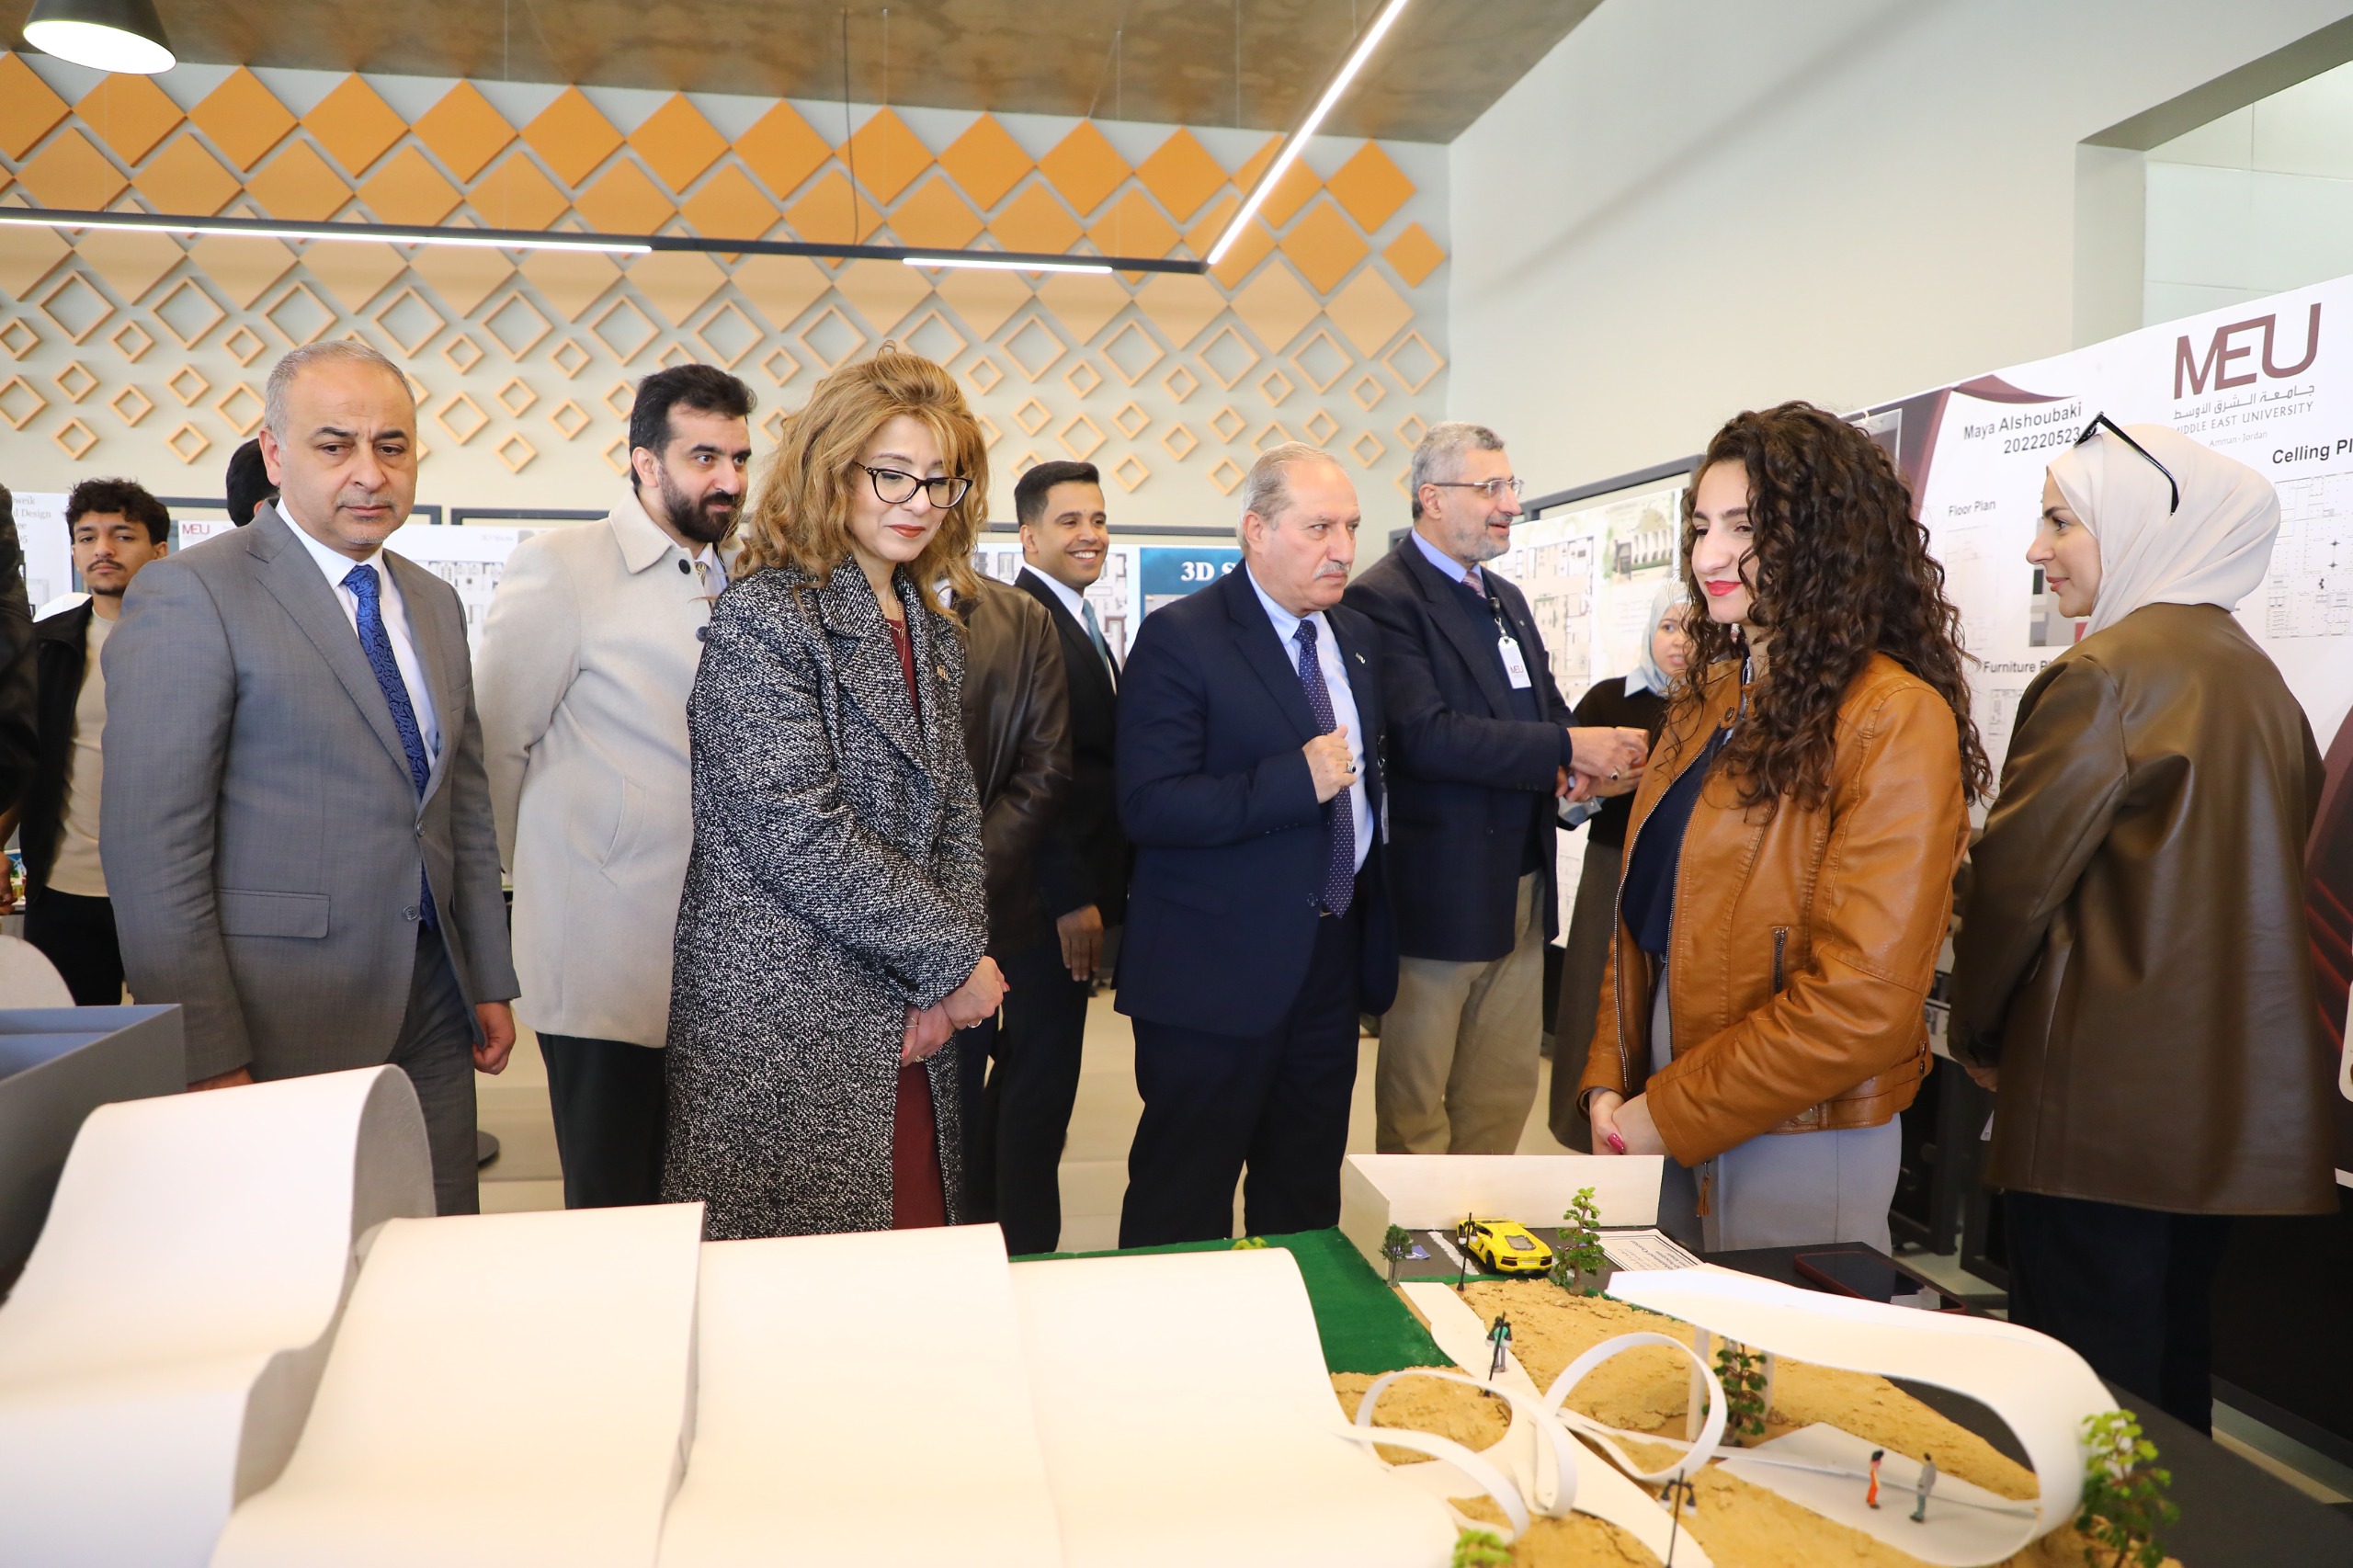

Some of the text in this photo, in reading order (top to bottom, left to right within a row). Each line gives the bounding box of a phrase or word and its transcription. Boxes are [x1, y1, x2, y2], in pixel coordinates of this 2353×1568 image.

[2173, 302, 2322, 400] MEU
[1963, 402, 2082, 440] Maya Alshoubaki
[2211, 415, 2237, 429] EAST
[2243, 402, 2314, 423] UNIVERSITY
[2004, 426, 2080, 454] 202220523
[2209, 436, 2237, 448] Amman
[2242, 430, 2268, 443] Jordan
[2272, 445, 2330, 464] Celling
[21, 508, 51, 520] Design
[1948, 501, 1996, 517] Floor Plan
[182, 523, 210, 535] MEU
[1180, 562, 1215, 582] 3D
[1984, 661, 2036, 673] Furniture
